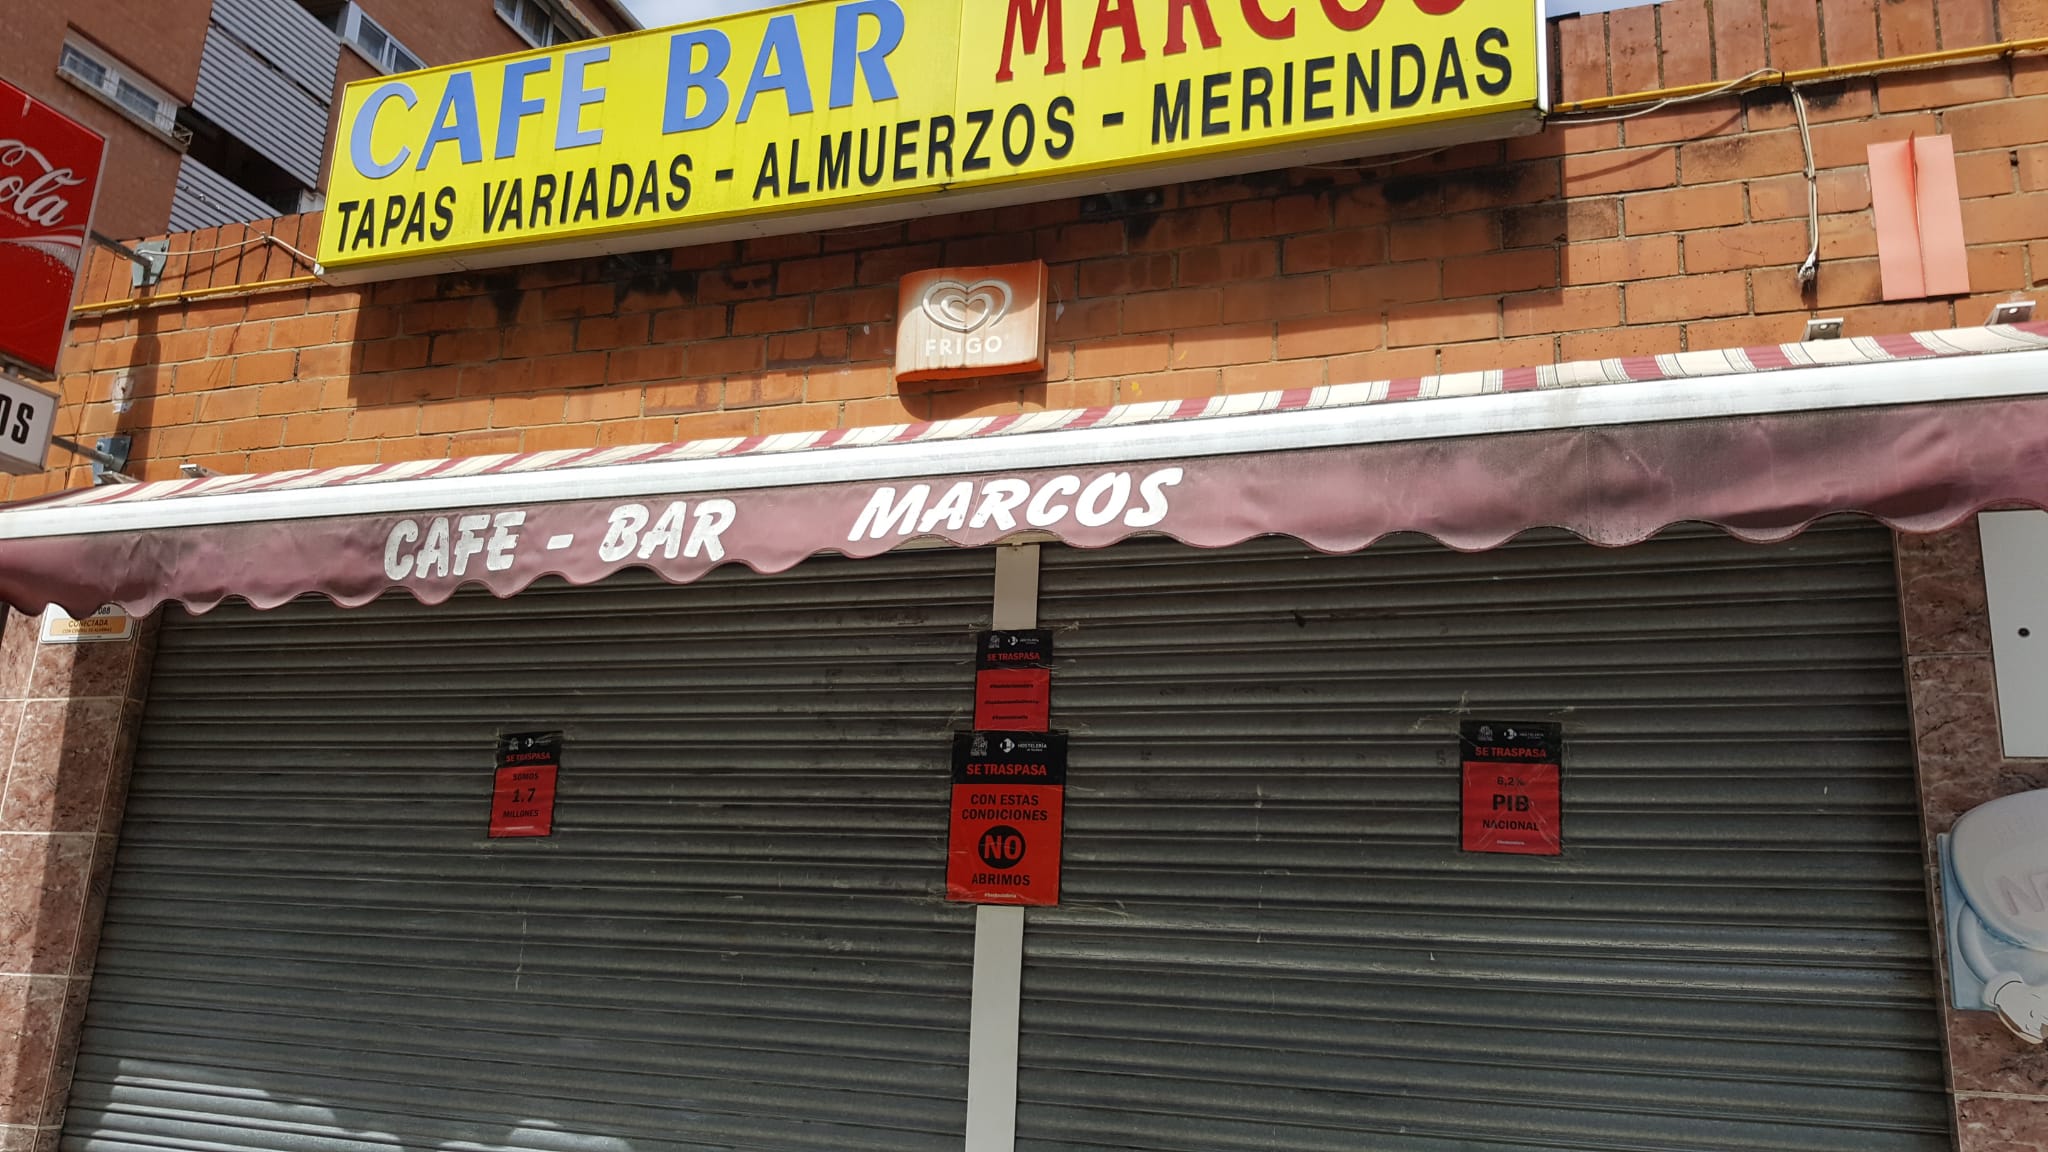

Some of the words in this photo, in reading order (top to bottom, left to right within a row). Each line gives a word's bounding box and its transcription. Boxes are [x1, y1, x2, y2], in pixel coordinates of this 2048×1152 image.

[350, 47, 610, 179] CAFE
[662, 0, 905, 135] BAR
[996, 0, 1464, 82] MAR
[338, 186, 455, 252] TAPAS
[483, 154, 693, 235] VARIADAS
[753, 96, 1074, 200] ALMUERZOS
[1151, 27, 1513, 145] MERIENDAS
[925, 335, 1003, 356] FRIGO
[384, 511, 526, 580] CAFE
[598, 499, 737, 562] BAR
[847, 467, 1184, 542] MARCOS
[998, 652, 1041, 661] TRASPASA
[1475, 746, 1489, 757] SE
[1491, 747, 1547, 758] TRASPASA
[966, 764, 981, 775] SE
[983, 764, 1047, 776] TRASPASA
[970, 794, 996, 805] CON
[1000, 794, 1039, 806] ESTAS
[1492, 793, 1530, 812] PIB
[503, 809, 540, 818] MILLONES
[961, 809, 1048, 821] CONDICIONES
[1482, 819, 1540, 831] NACIONAL
[984, 834, 1022, 860] NO
[971, 874, 1031, 886] ABRIMOS
